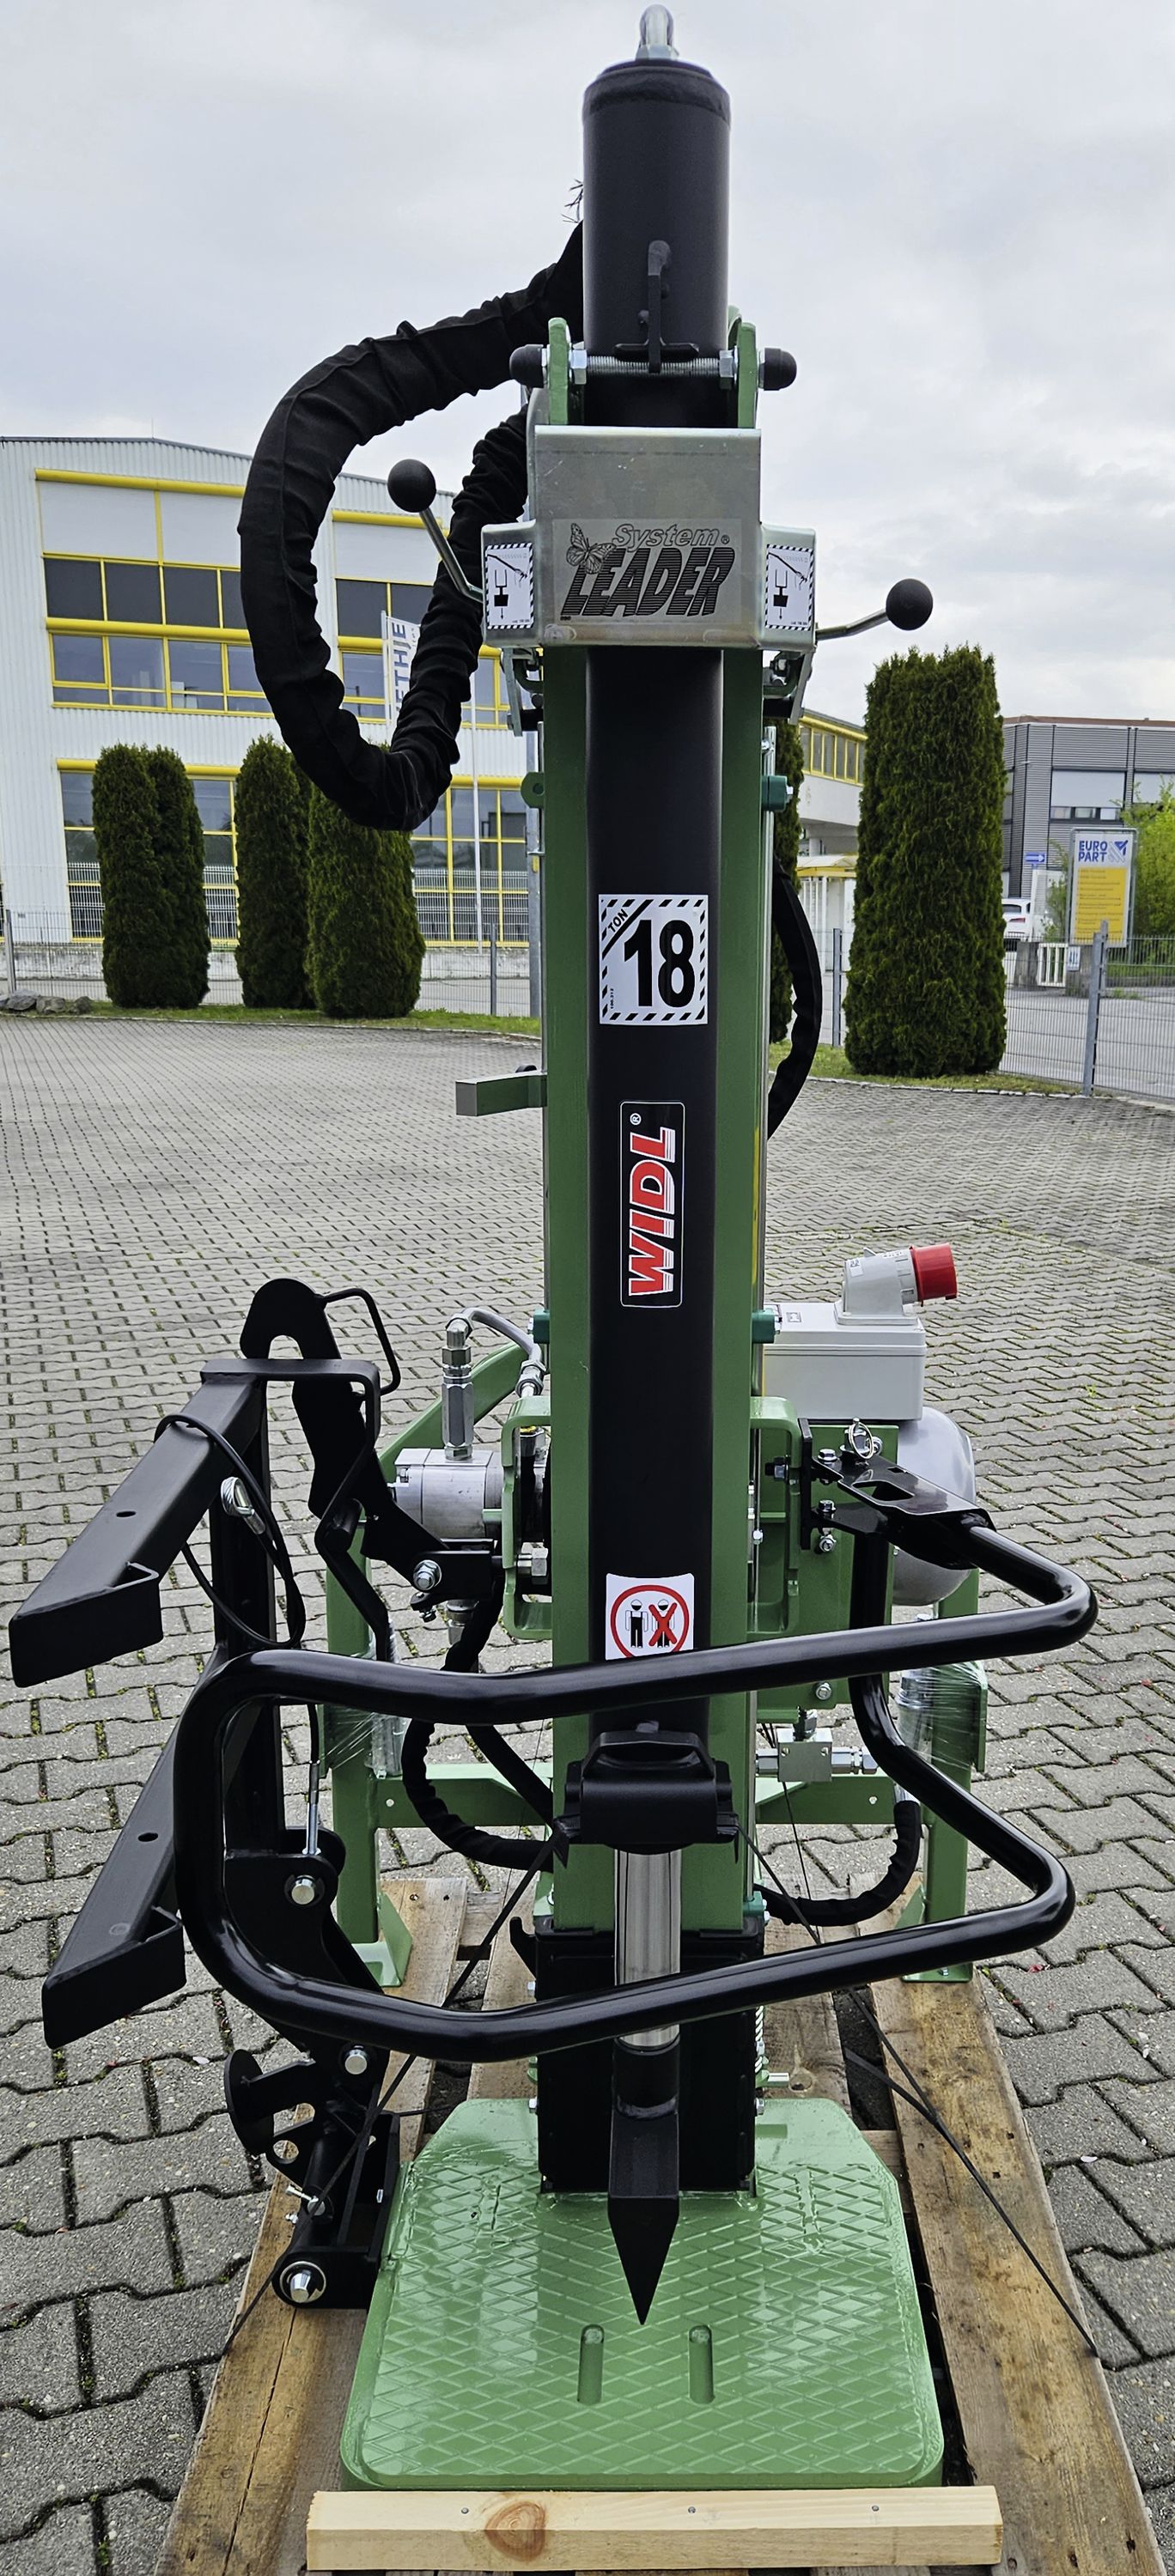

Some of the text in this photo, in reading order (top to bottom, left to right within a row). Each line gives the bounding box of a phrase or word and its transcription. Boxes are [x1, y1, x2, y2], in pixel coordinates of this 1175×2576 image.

[561, 547, 736, 617] LEADER
[1078, 852, 1107, 863] PART
[1079, 840, 1108, 852] EURO
[607, 908, 629, 933] TON
[624, 920, 696, 1008] 18
